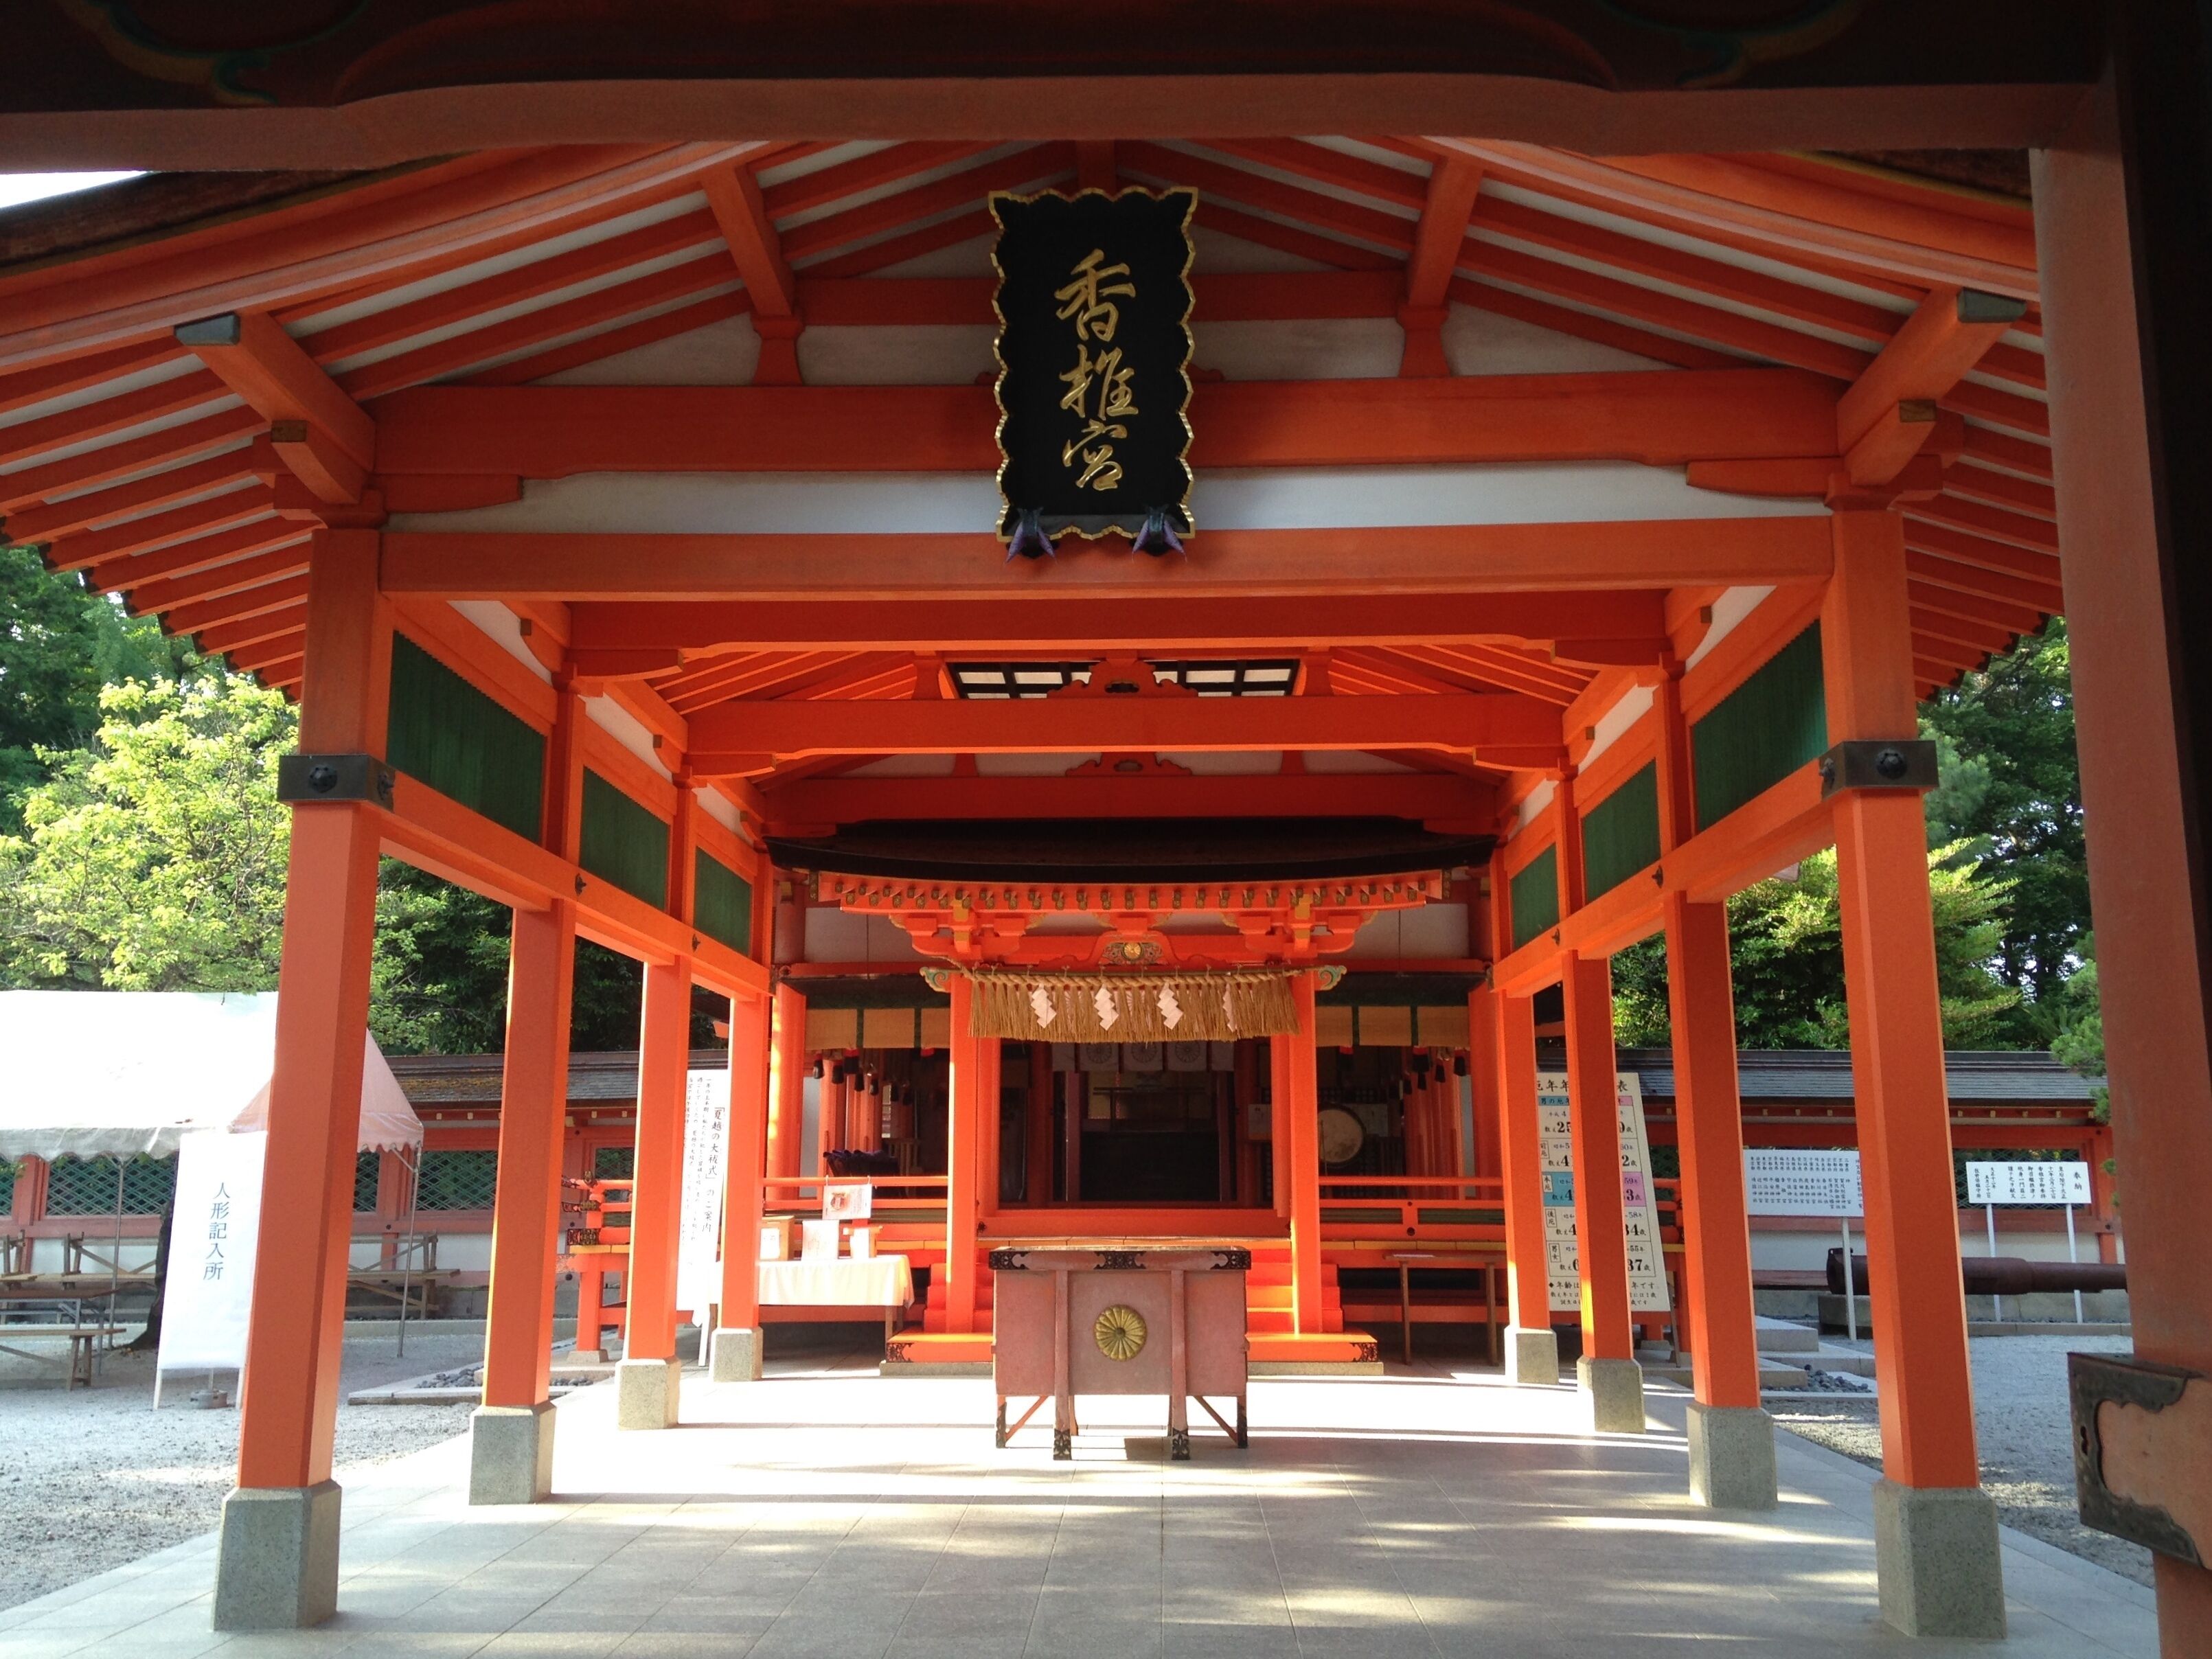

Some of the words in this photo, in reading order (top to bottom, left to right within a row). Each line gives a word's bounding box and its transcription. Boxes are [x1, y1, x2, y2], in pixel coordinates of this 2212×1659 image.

[1054, 248, 1139, 491] 香椎宮
[1617, 1079, 1628, 1092] 表
[2073, 1171, 2082, 1191] 奉納
[1547, 1211, 1555, 1225] 後厄
[203, 1182, 231, 1281] 人形記入所
